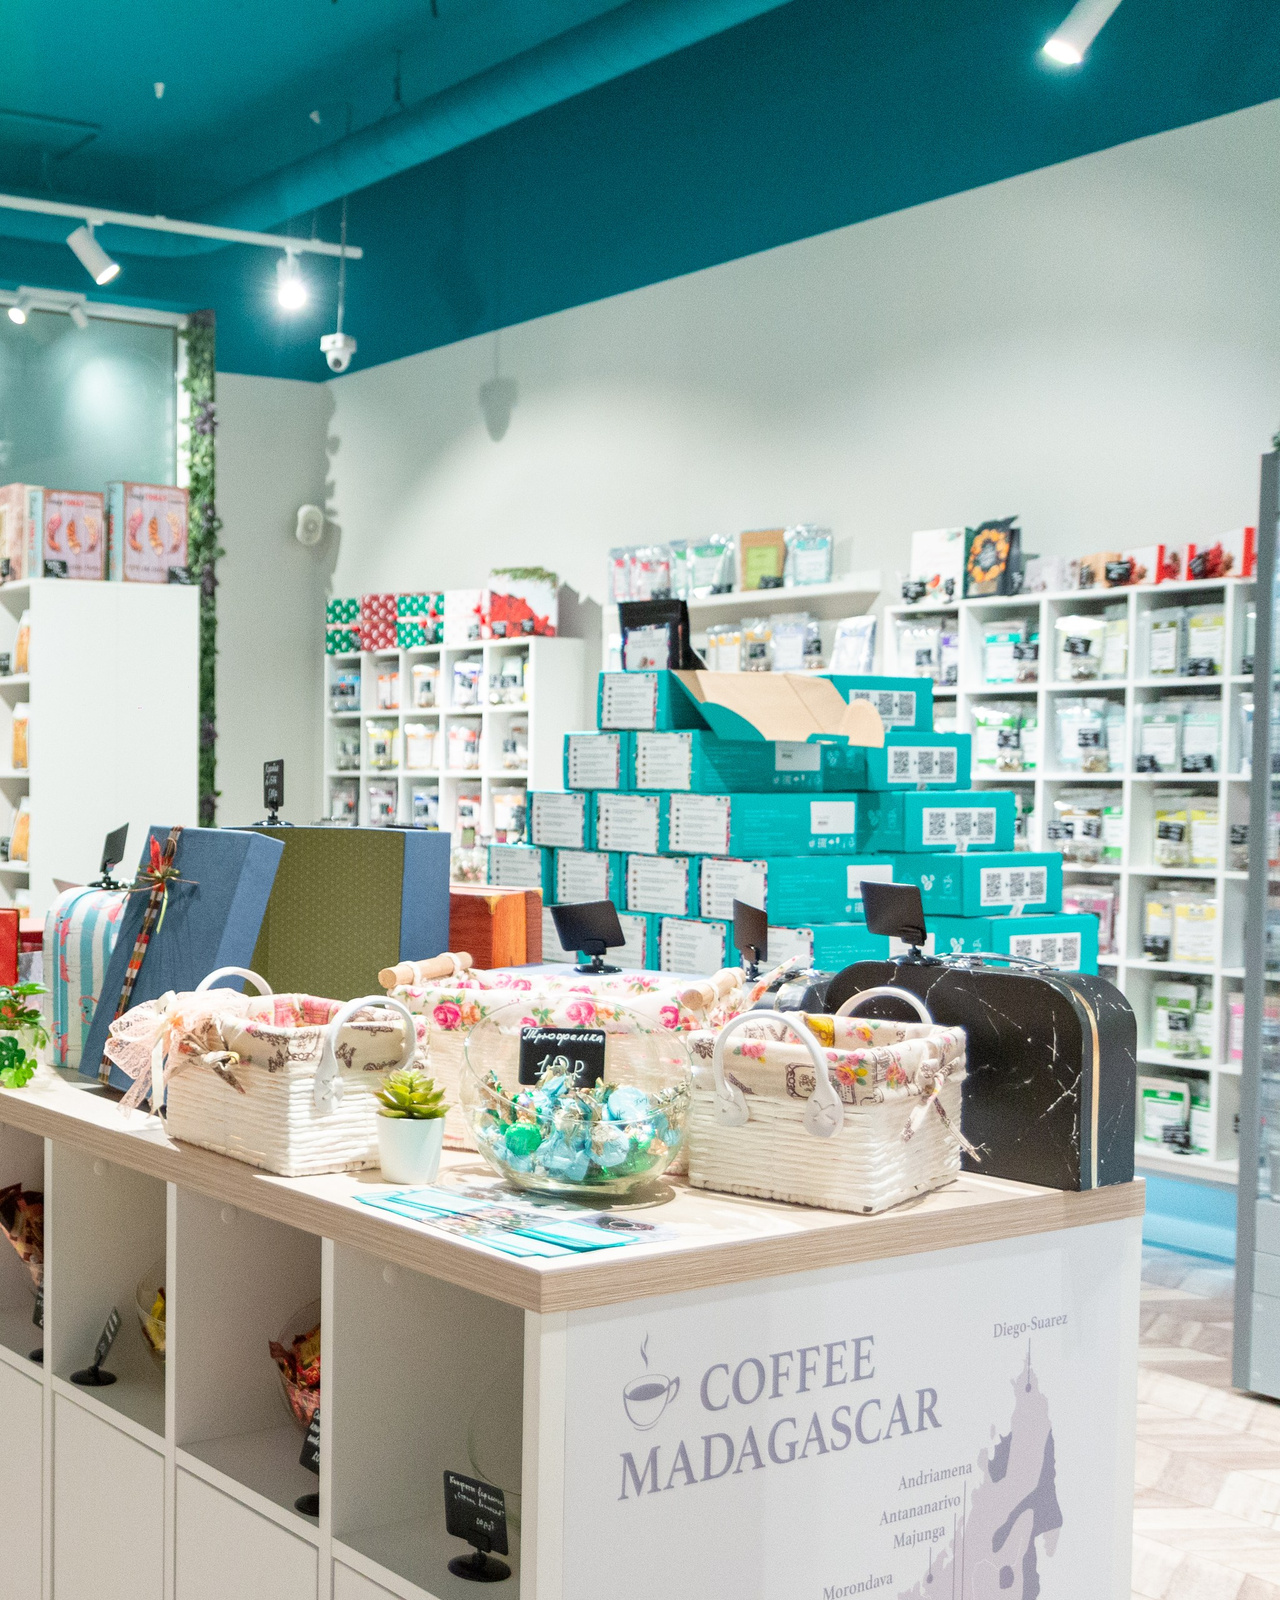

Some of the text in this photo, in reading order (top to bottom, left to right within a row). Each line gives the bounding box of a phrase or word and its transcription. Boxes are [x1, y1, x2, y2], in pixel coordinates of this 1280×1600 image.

[993, 1314, 1068, 1339] Diego-Suarez
[699, 1335, 876, 1412] COFFEE
[618, 1387, 942, 1501] MADAGASCAR
[897, 1462, 973, 1491] Andriamena
[878, 1494, 962, 1527] Antananarivo
[892, 1525, 946, 1550] Majunga
[821, 1573, 894, 1600] Morondava
